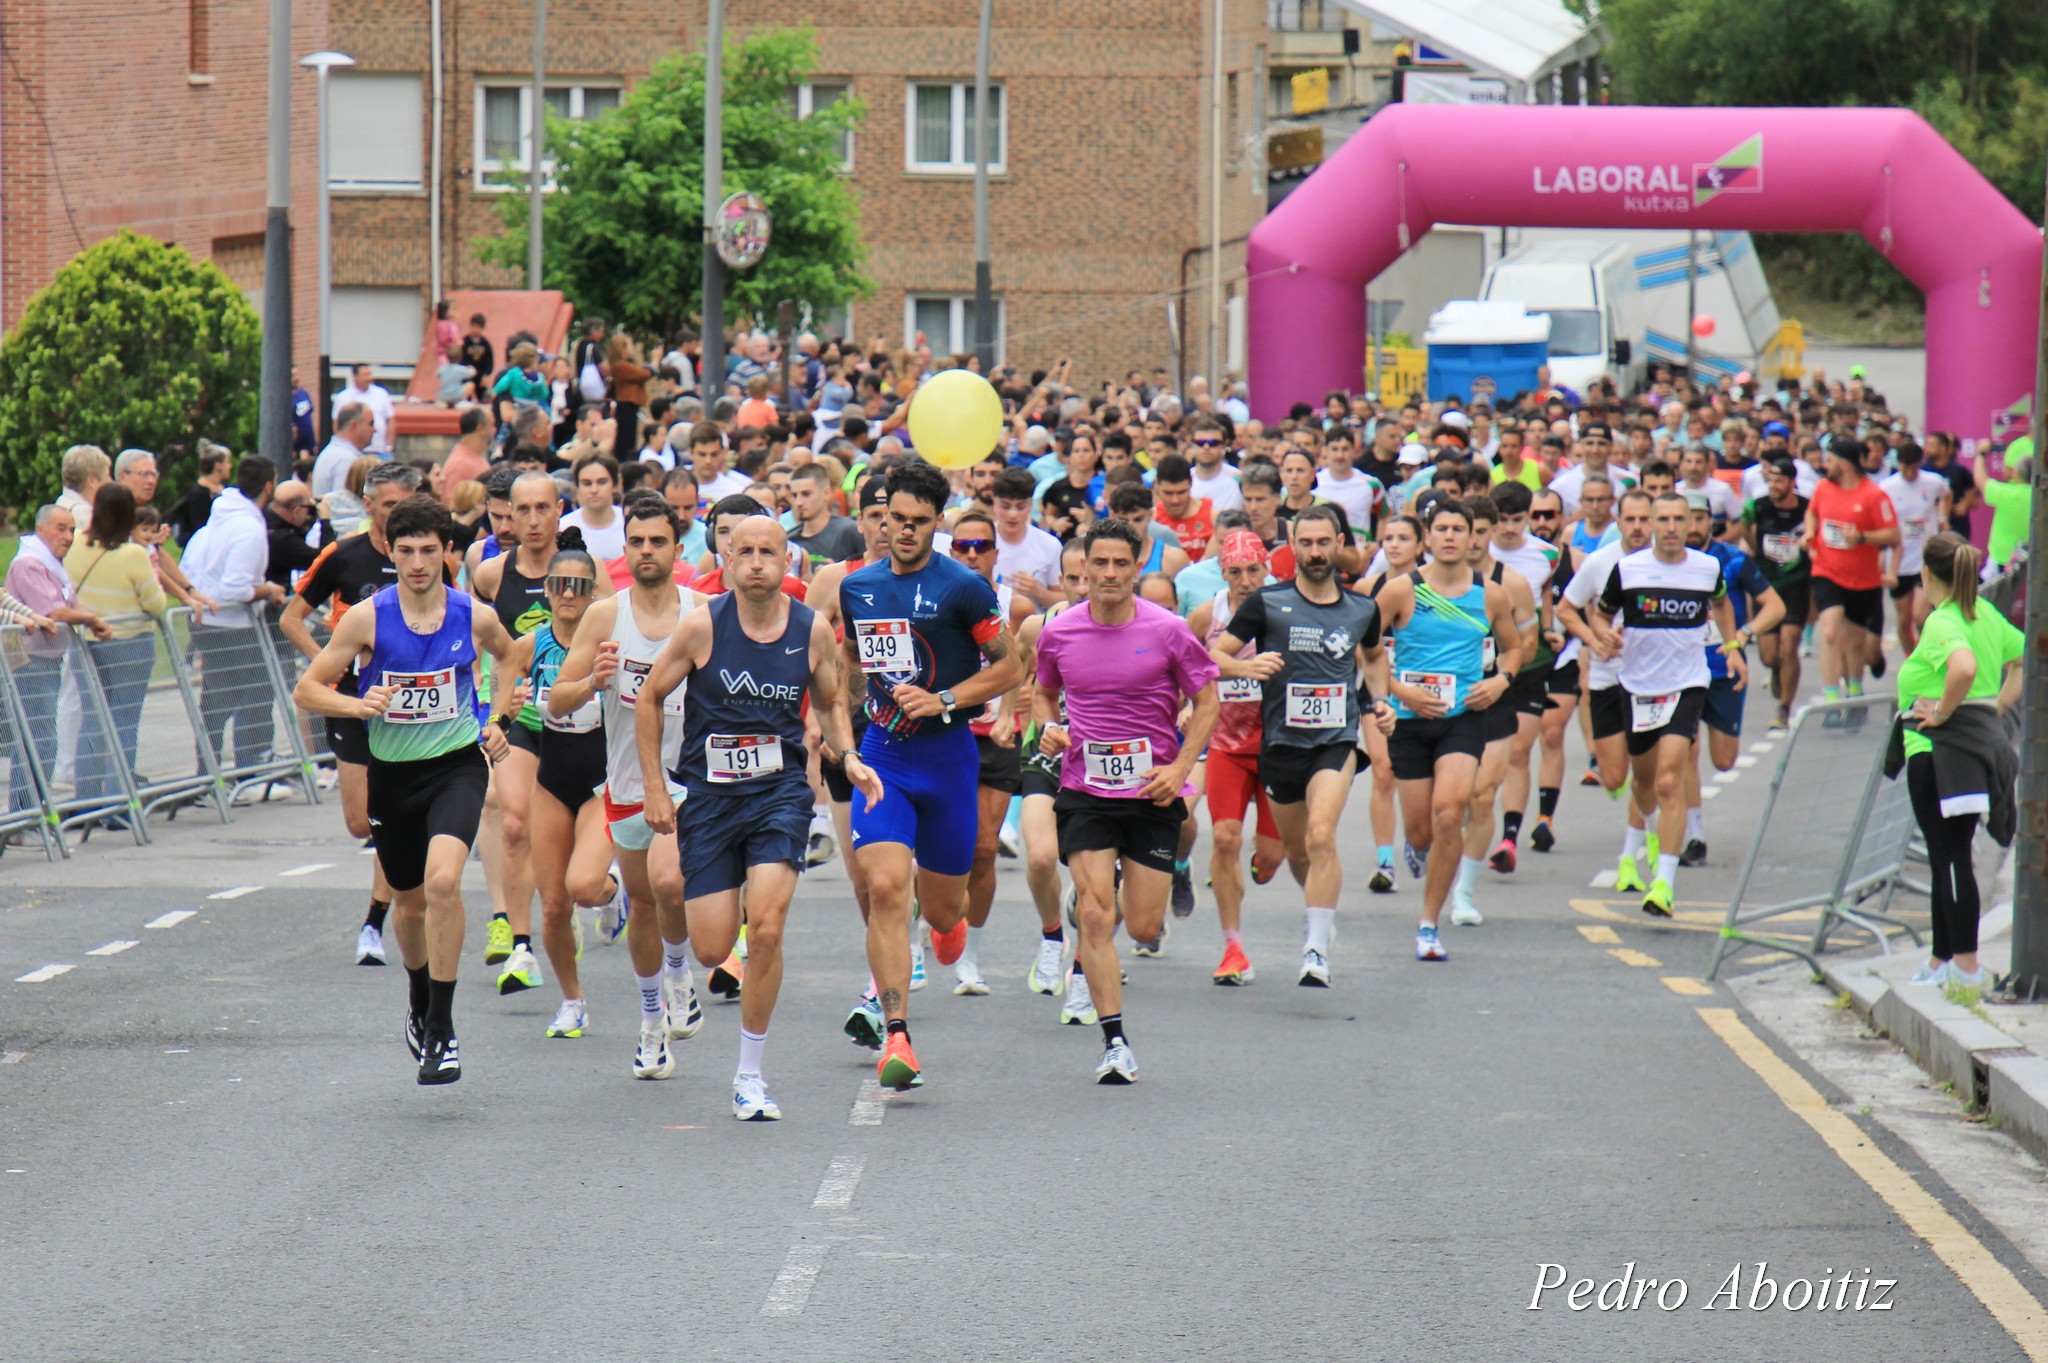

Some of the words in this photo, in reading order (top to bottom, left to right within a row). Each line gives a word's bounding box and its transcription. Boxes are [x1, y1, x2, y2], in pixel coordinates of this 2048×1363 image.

[1533, 164, 1689, 193] LABORAL
[1624, 194, 1689, 212] kutxa
[865, 636, 896, 658] 349
[402, 688, 440, 709] 279
[1302, 698, 1331, 716] 281
[724, 747, 760, 770] 191
[1099, 756, 1134, 776] 184
